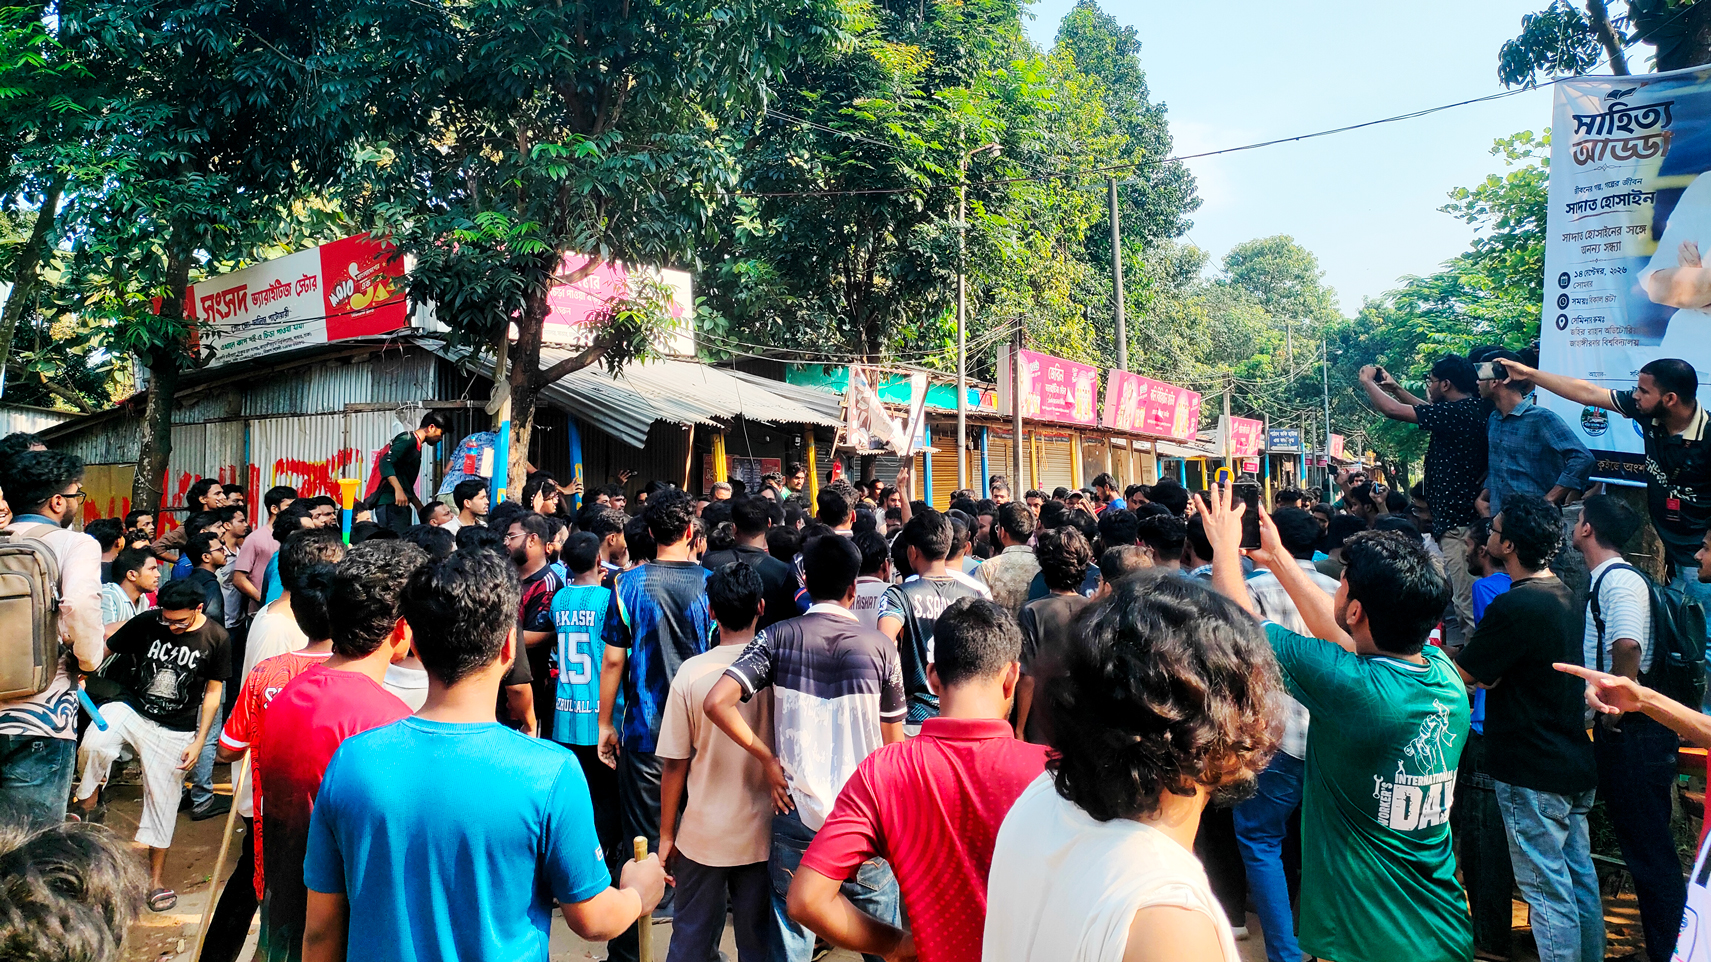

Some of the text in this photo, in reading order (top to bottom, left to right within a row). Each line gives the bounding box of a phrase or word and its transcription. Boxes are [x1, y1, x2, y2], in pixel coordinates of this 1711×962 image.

[1572, 101, 1675, 135] সাহিত্য
[1572, 131, 1675, 166] আড্ডা
[1622, 177, 1643, 186] জীবন
[1565, 189, 1656, 214] সাদাত হোসাইন
[1562, 225, 1647, 242] সাদাত হোসাইনের সঙ্গে
[1581, 241, 1621, 254] অনন্য সন্ধ্যা
[200, 273, 317, 323] সংসদ ভ্যারাইটিজ স্টোর
[555, 610, 596, 627] AKASH
[557, 632, 592, 685] 15
[1378, 782, 1393, 826] WORKER'S
